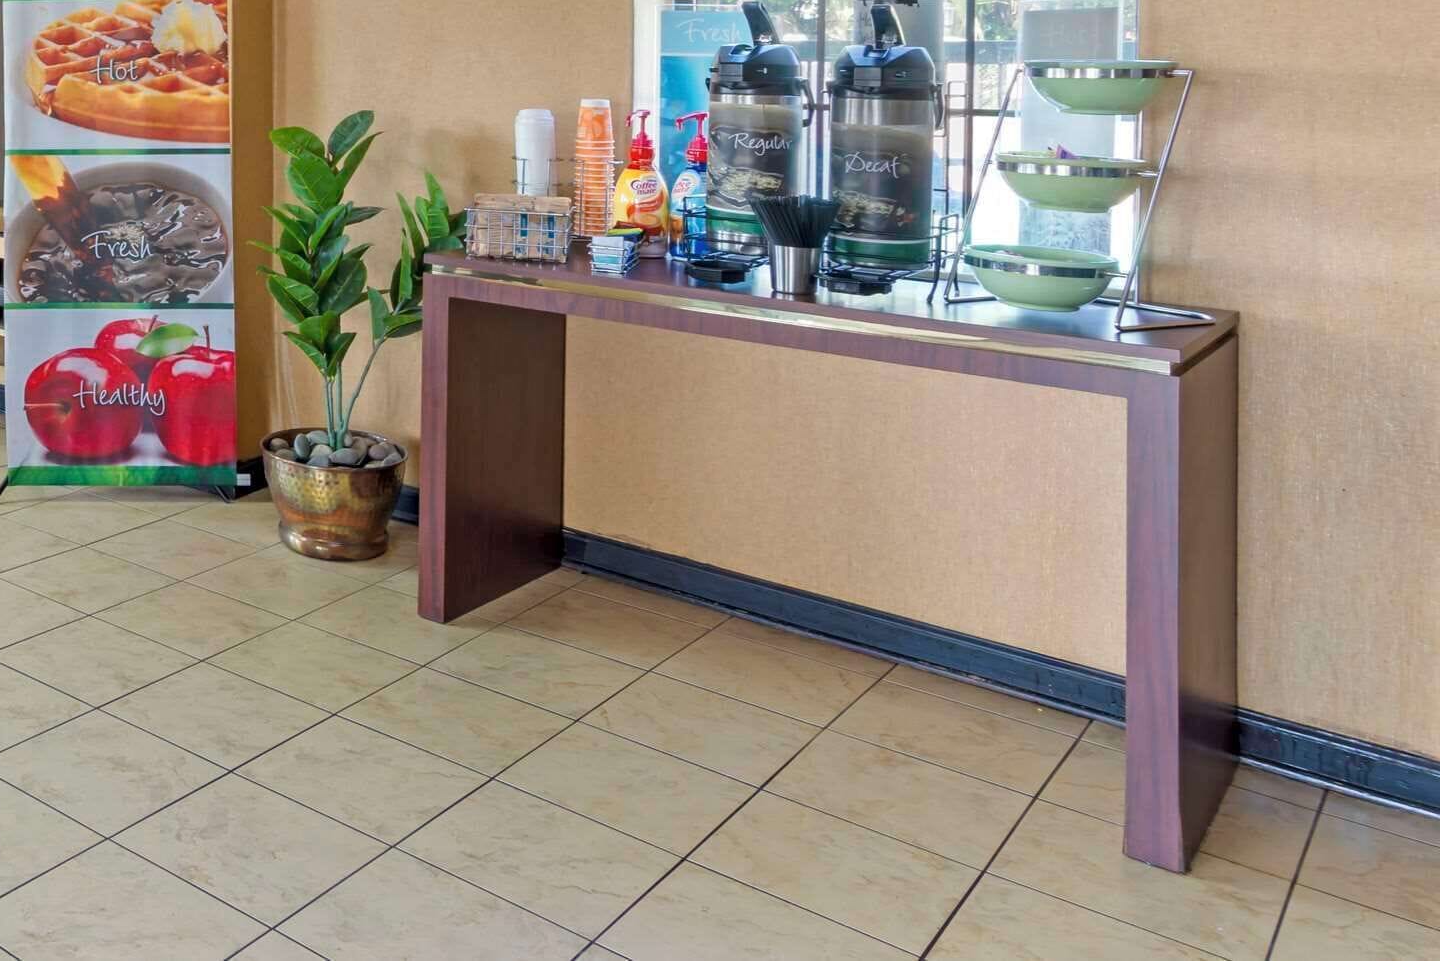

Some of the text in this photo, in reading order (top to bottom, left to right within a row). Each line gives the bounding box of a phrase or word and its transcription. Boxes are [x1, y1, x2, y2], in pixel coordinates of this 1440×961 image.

[675, 17, 740, 44] Fresh
[89, 49, 140, 85] Hot
[728, 132, 793, 156] Regular
[844, 151, 901, 179] Decaf
[80, 230, 152, 260] Fresh
[72, 379, 166, 416] Healthy
